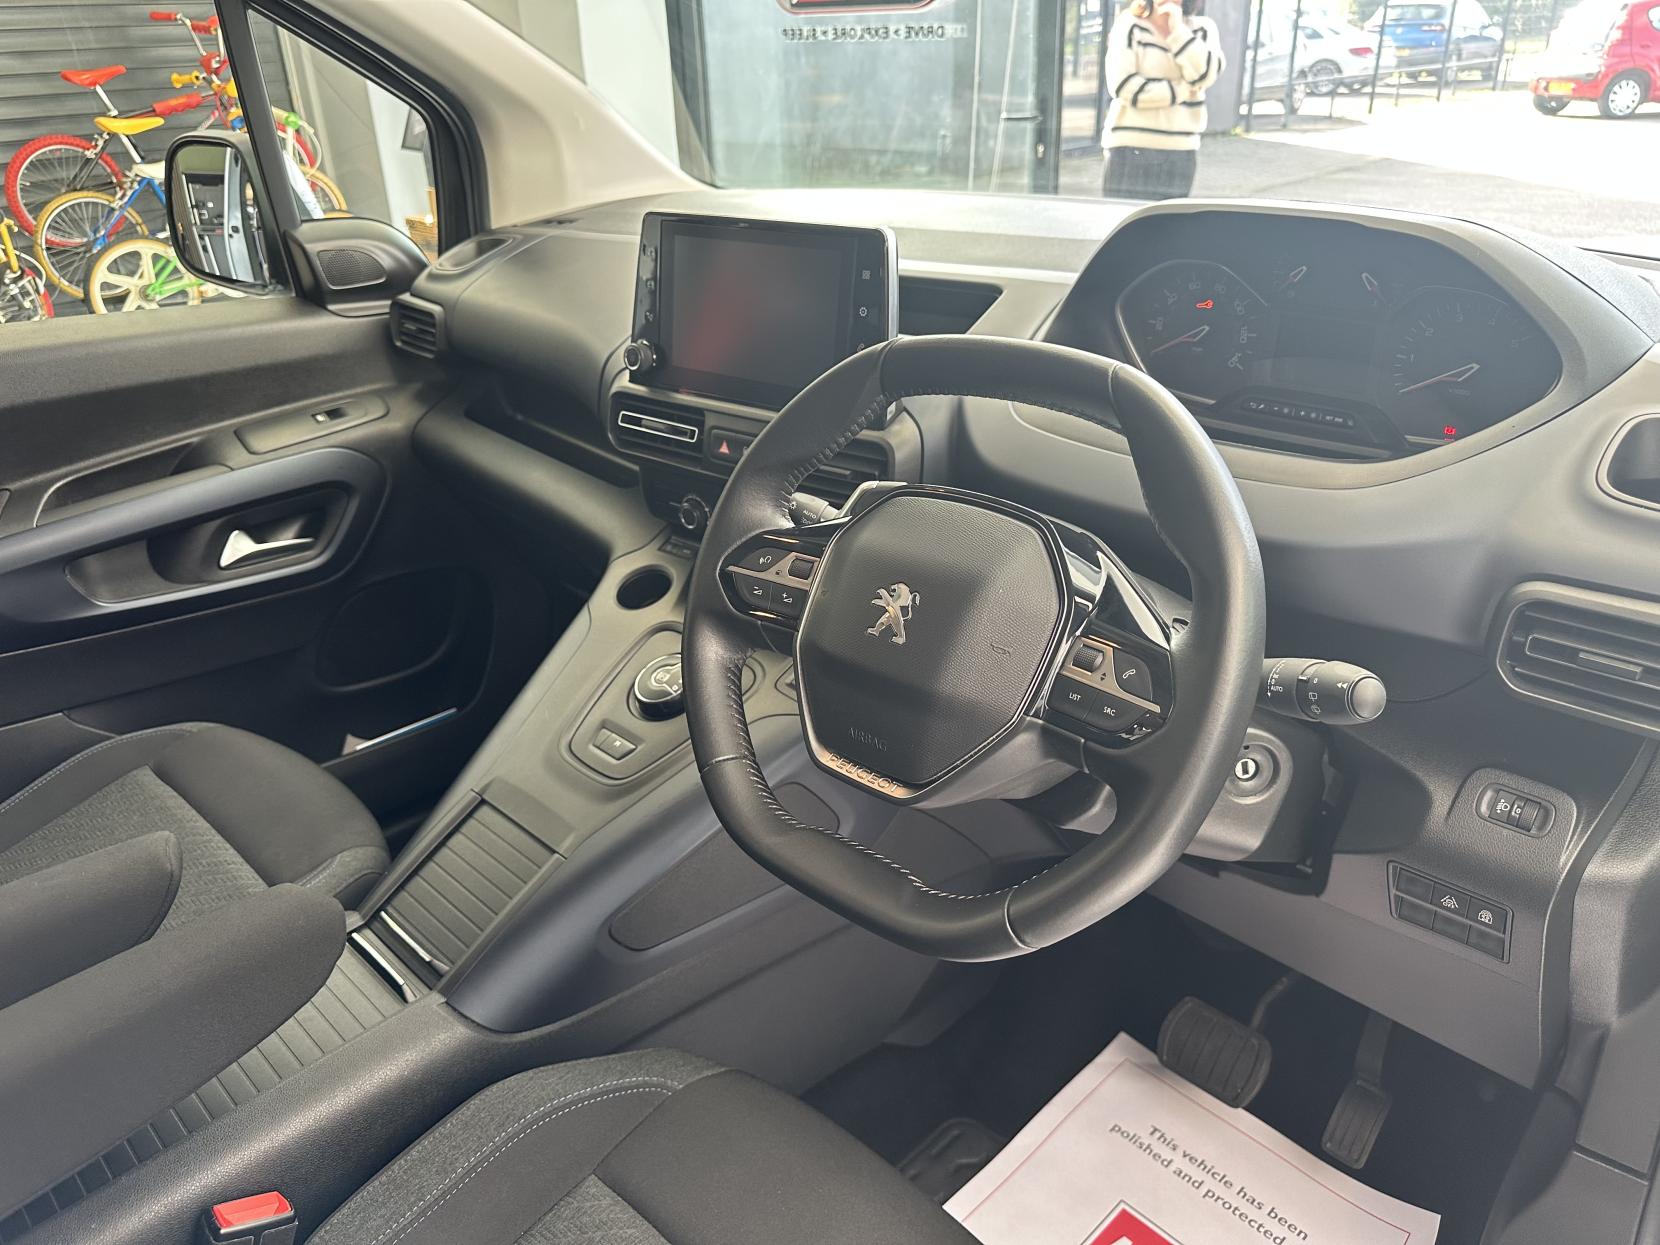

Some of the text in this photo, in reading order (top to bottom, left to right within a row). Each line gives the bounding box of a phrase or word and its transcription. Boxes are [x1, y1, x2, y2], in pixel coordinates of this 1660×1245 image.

[1455, 313, 1464, 323] 3
[1424, 327, 1434, 337] 2
[803, 509, 817, 519] AUTO
[1270, 685, 1284, 693] AUTO
[1069, 691, 1082, 702] LIST
[1103, 705, 1116, 716] SRC
[848, 727, 888, 752] AIRBAG
[828, 752, 904, 793] PEUGEOT
[1108, 1122, 1287, 1245] polished and protected
[1147, 1123, 1309, 1242] This vehicle has been
